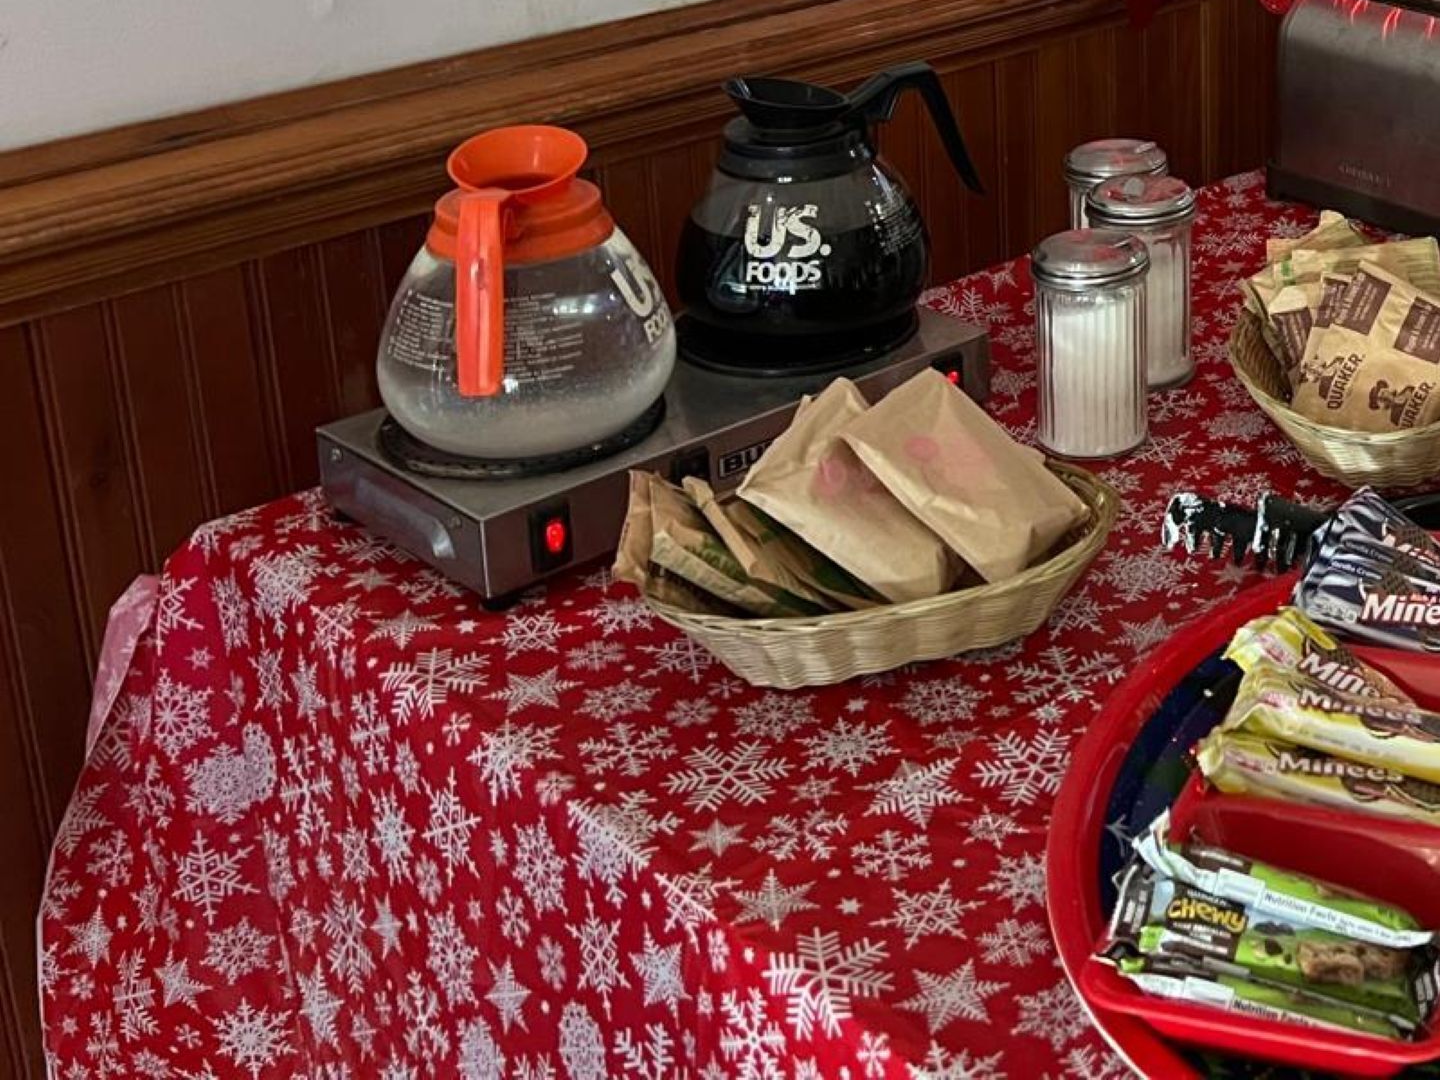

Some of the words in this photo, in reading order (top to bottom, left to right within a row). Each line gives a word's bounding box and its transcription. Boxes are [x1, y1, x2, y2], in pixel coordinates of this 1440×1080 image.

[745, 260, 822, 283] FOODS
[1327, 353, 1363, 411] QUAKER
[1401, 382, 1434, 429] UAKER
[1299, 651, 1382, 699] Mine
